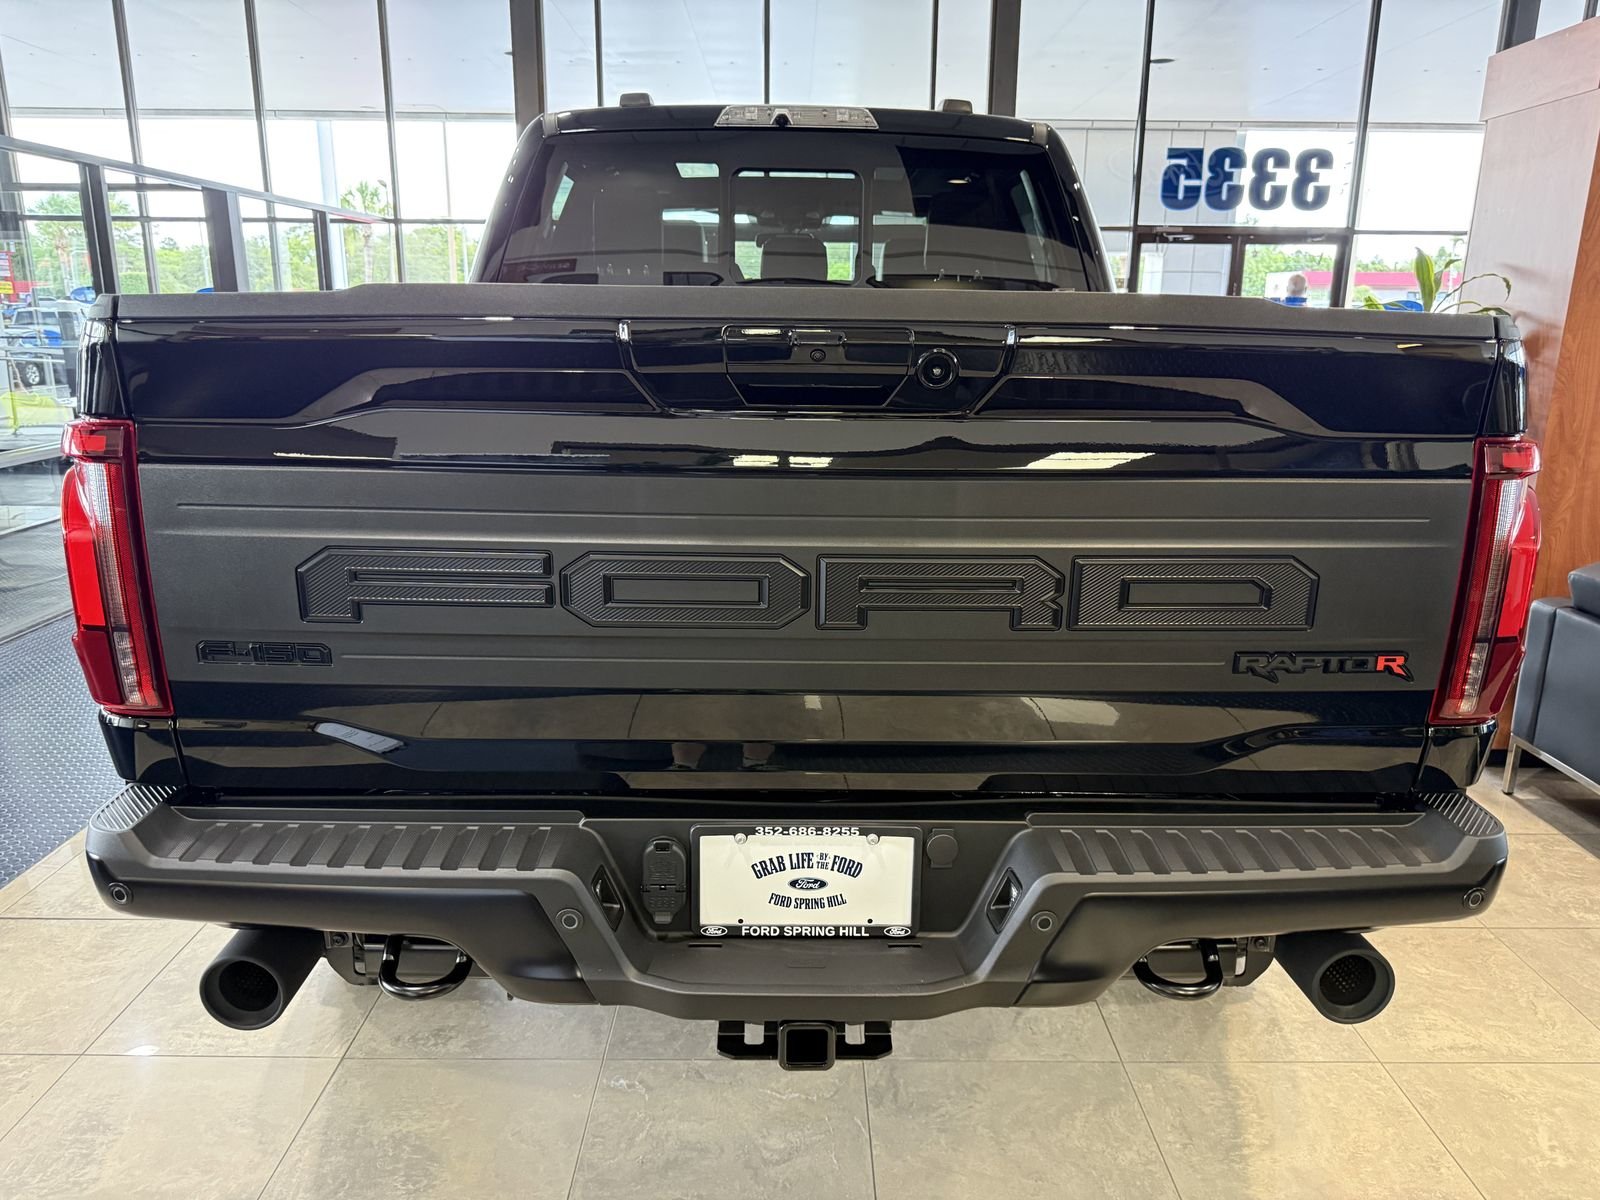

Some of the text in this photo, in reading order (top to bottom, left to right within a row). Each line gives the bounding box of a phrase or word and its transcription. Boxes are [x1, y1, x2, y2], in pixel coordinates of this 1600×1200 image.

[295, 546, 1321, 632] FORD
[196, 640, 333, 666] F-150
[1232, 651, 1414, 684] RAPTOR
[755, 826, 860, 836] 352-686-8255
[751, 855, 787, 879] GRAB
[788, 852, 814, 870] LIFE
[816, 861, 830, 870] THE
[830, 854, 863, 879] FORD
[795, 879, 821, 889] Ford
[768, 892, 847, 910] FORD SPRING HILL
[741, 926, 870, 937] FORD SPRING HILL
